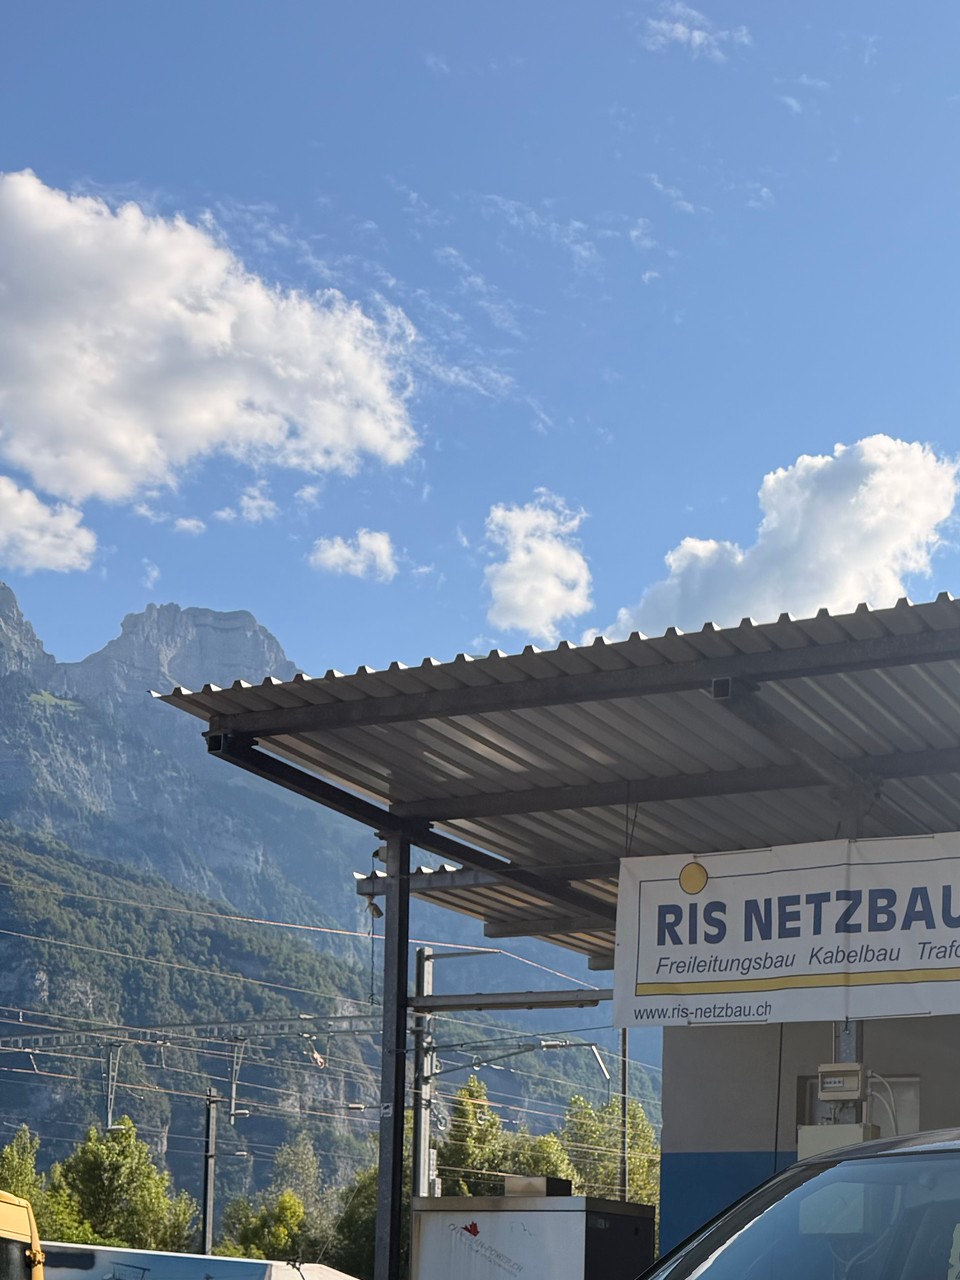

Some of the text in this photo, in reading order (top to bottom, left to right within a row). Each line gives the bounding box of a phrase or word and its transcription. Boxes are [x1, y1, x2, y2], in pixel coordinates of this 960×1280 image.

[657, 901, 727, 946] RIS
[656, 952, 796, 976] Freileitungsbau
[808, 944, 901, 966] Kabelbau
[633, 1000, 772, 1020] www.ris-netzbau.ch
